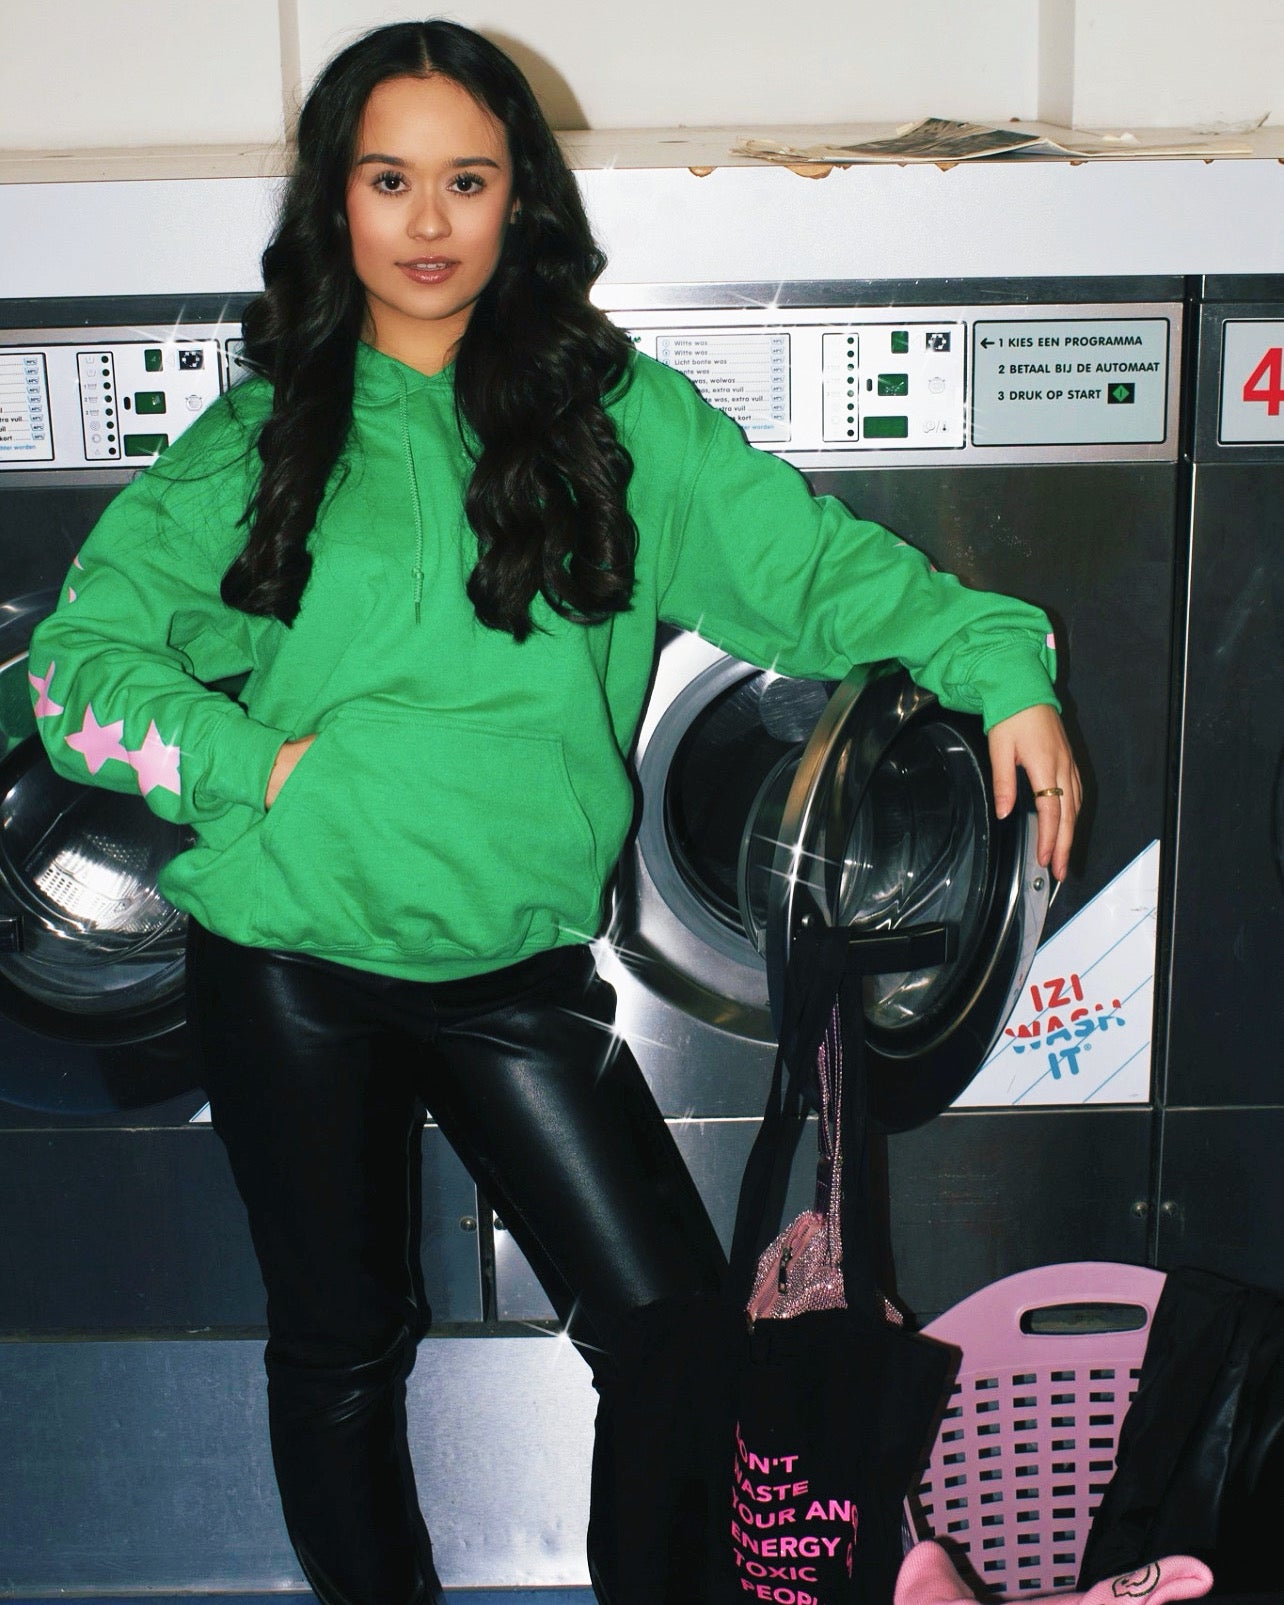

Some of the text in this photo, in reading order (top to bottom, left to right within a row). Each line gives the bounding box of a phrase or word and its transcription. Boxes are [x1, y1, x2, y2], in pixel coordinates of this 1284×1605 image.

[998, 335, 1143, 348] 1 KIES EEN PROGRAMMA
[998, 362, 1160, 374] 2 BETAAL BIJ DE AUTOMAAT
[1243, 347, 1284, 416] 4
[998, 389, 1102, 401] 3 DRUK OP START
[1030, 973, 1084, 1013] IZI
[1004, 998, 1126, 1054] WASH
[731, 1519, 842, 1558] ENERGY
[733, 1547, 819, 1583] TOXIC
